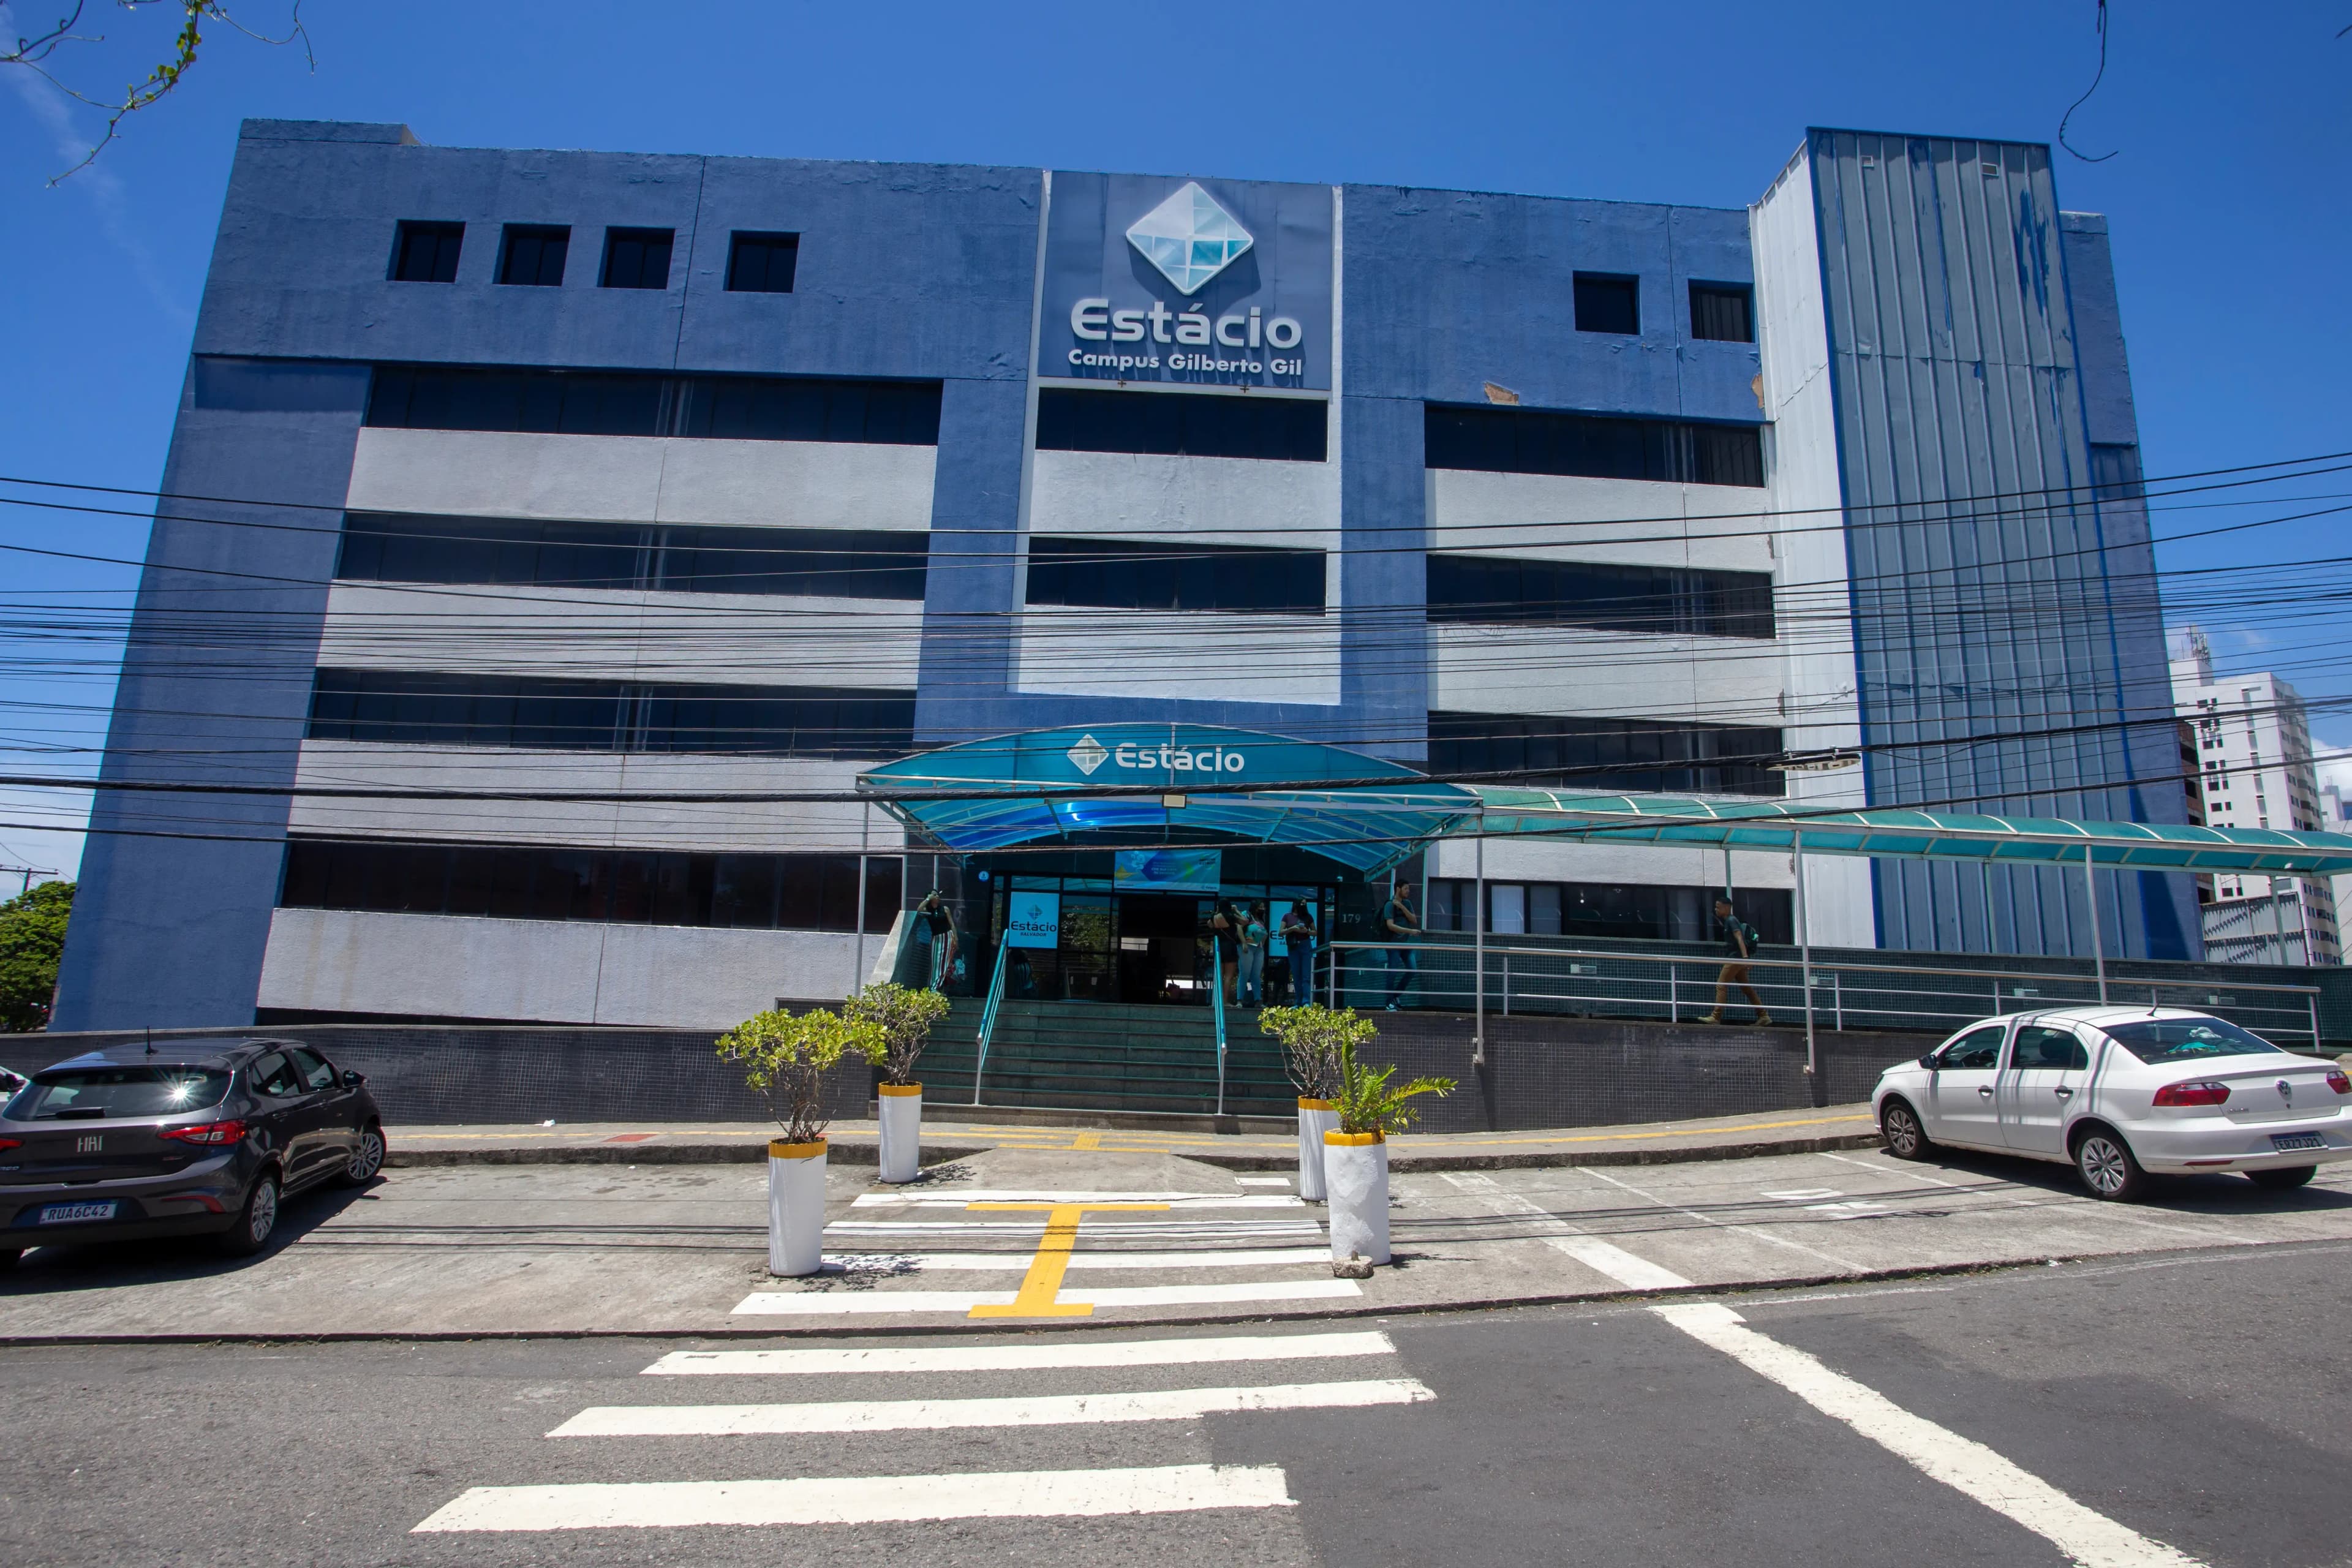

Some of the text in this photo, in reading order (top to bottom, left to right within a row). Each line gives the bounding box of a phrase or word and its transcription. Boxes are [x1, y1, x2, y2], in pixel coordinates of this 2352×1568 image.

[1071, 298, 1302, 349] Estácio
[1068, 349, 1302, 375] Campus Gilberto Gil
[1115, 742, 1245, 772] Estácio
[1011, 921, 1057, 932] Estácio
[1343, 914, 1361, 924] 179
[77, 1136, 103, 1152] FIAT
[48, 1205, 108, 1221] RUA6C42
